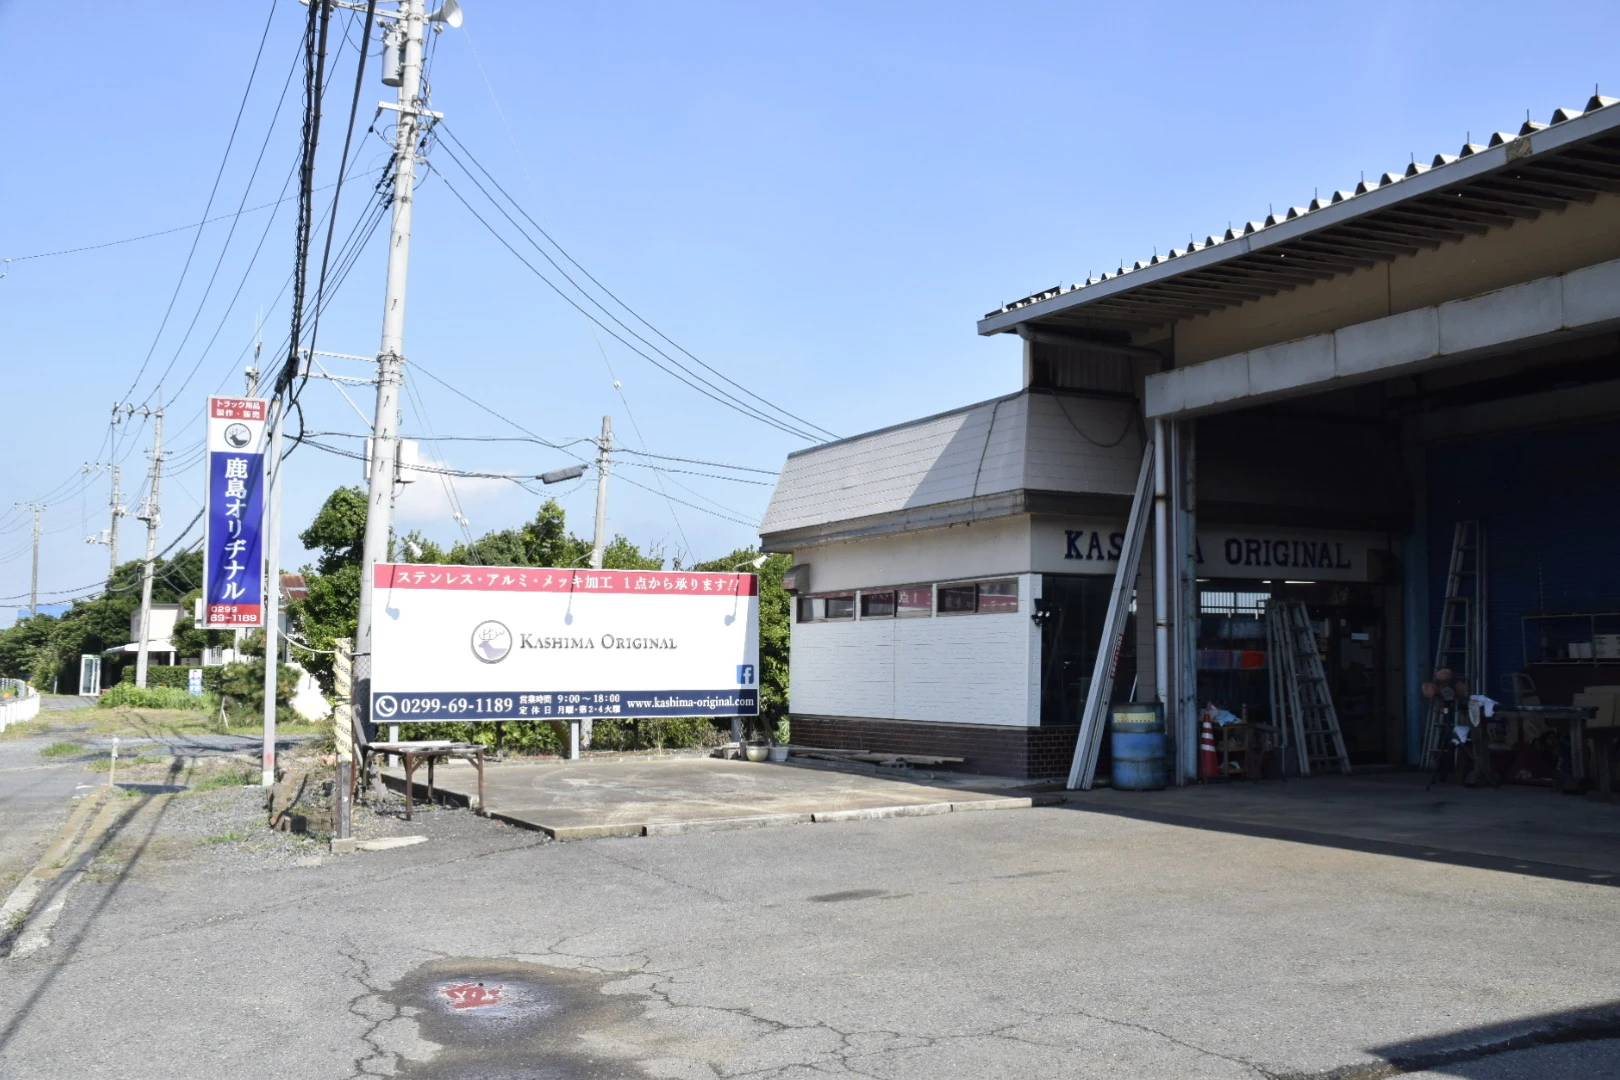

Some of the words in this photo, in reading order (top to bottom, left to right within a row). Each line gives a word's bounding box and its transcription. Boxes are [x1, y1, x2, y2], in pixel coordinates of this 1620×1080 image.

[217, 400, 261, 410] トラック用品
[216, 408, 261, 419] 製作・販売
[223, 458, 248, 600] 鹿島オリヂナル
[1225, 537, 1352, 569] ORIGINAL
[210, 614, 257, 622] 69-1189
[400, 697, 514, 714] 0299-69-1189
[519, 694, 552, 704] 営業時間
[626, 695, 754, 710] www.kashima-original.com
